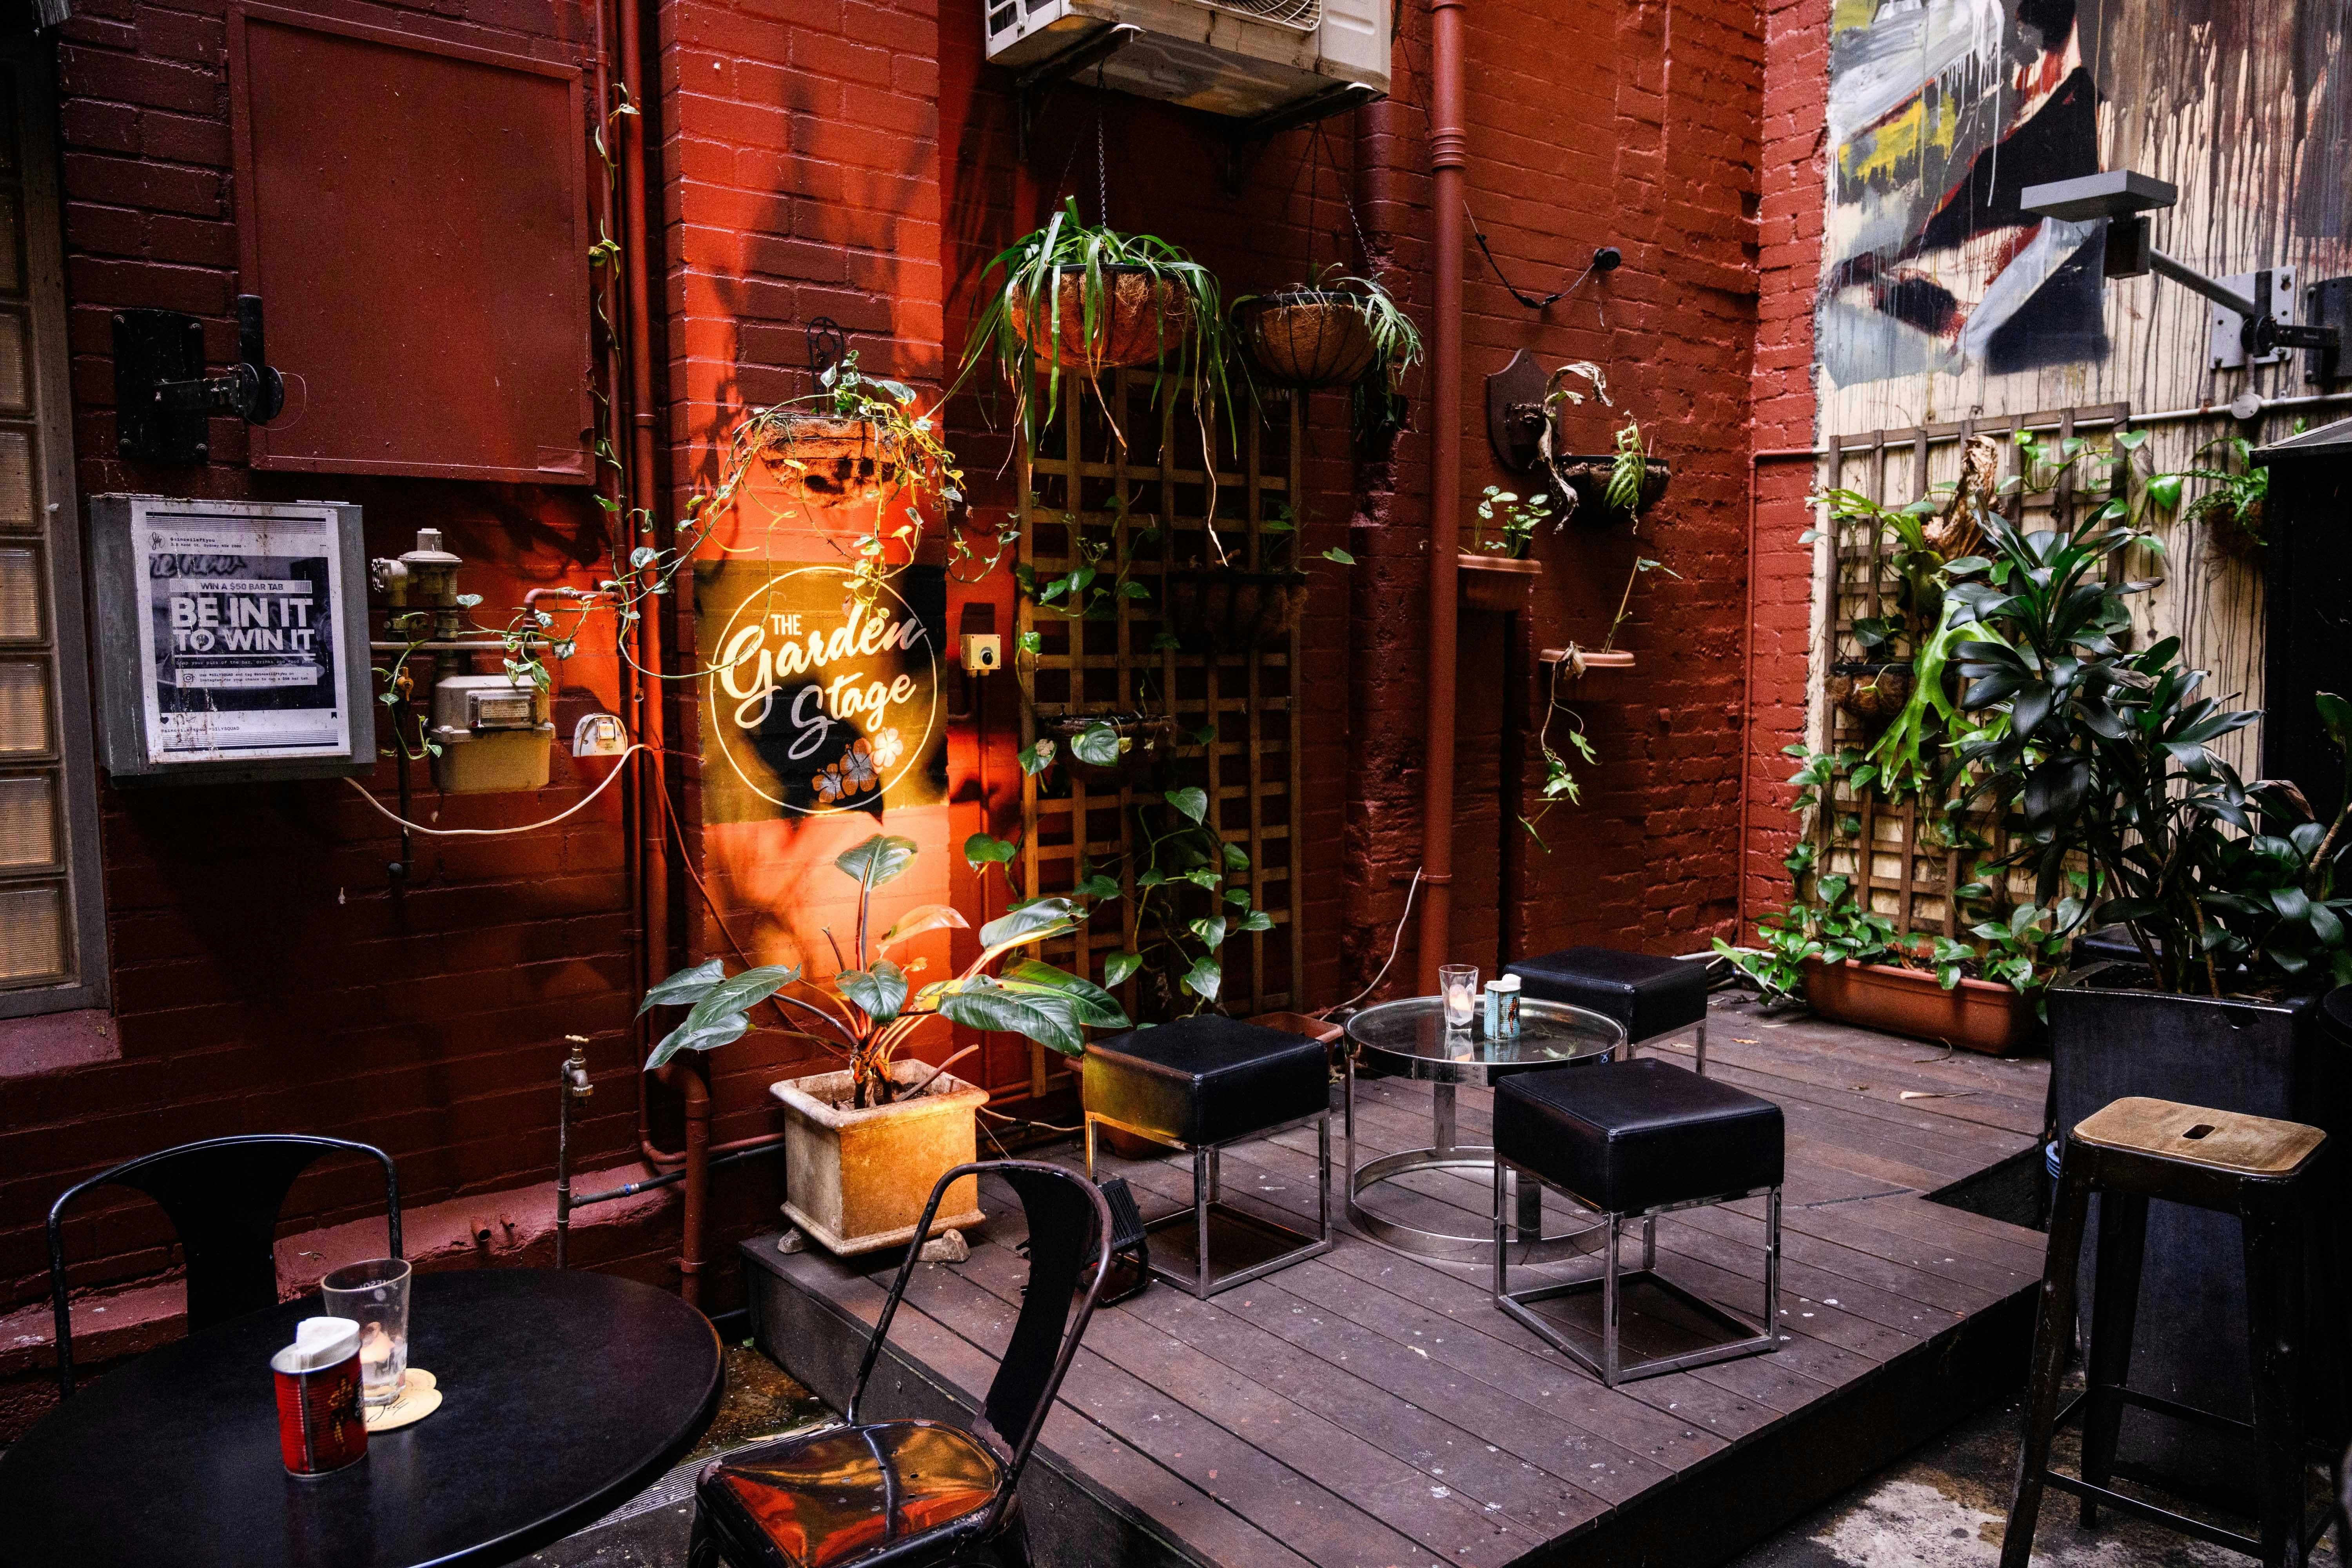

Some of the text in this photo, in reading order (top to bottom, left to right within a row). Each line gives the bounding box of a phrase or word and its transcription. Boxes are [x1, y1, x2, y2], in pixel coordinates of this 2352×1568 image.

[229, 583, 247, 591] $50
[170, 597, 313, 627] BE IN IT
[770, 614, 802, 635] THE
[172, 629, 315, 652] TO WIN IT
[706, 600, 927, 728] Garden
[788, 672, 916, 760] Stage
